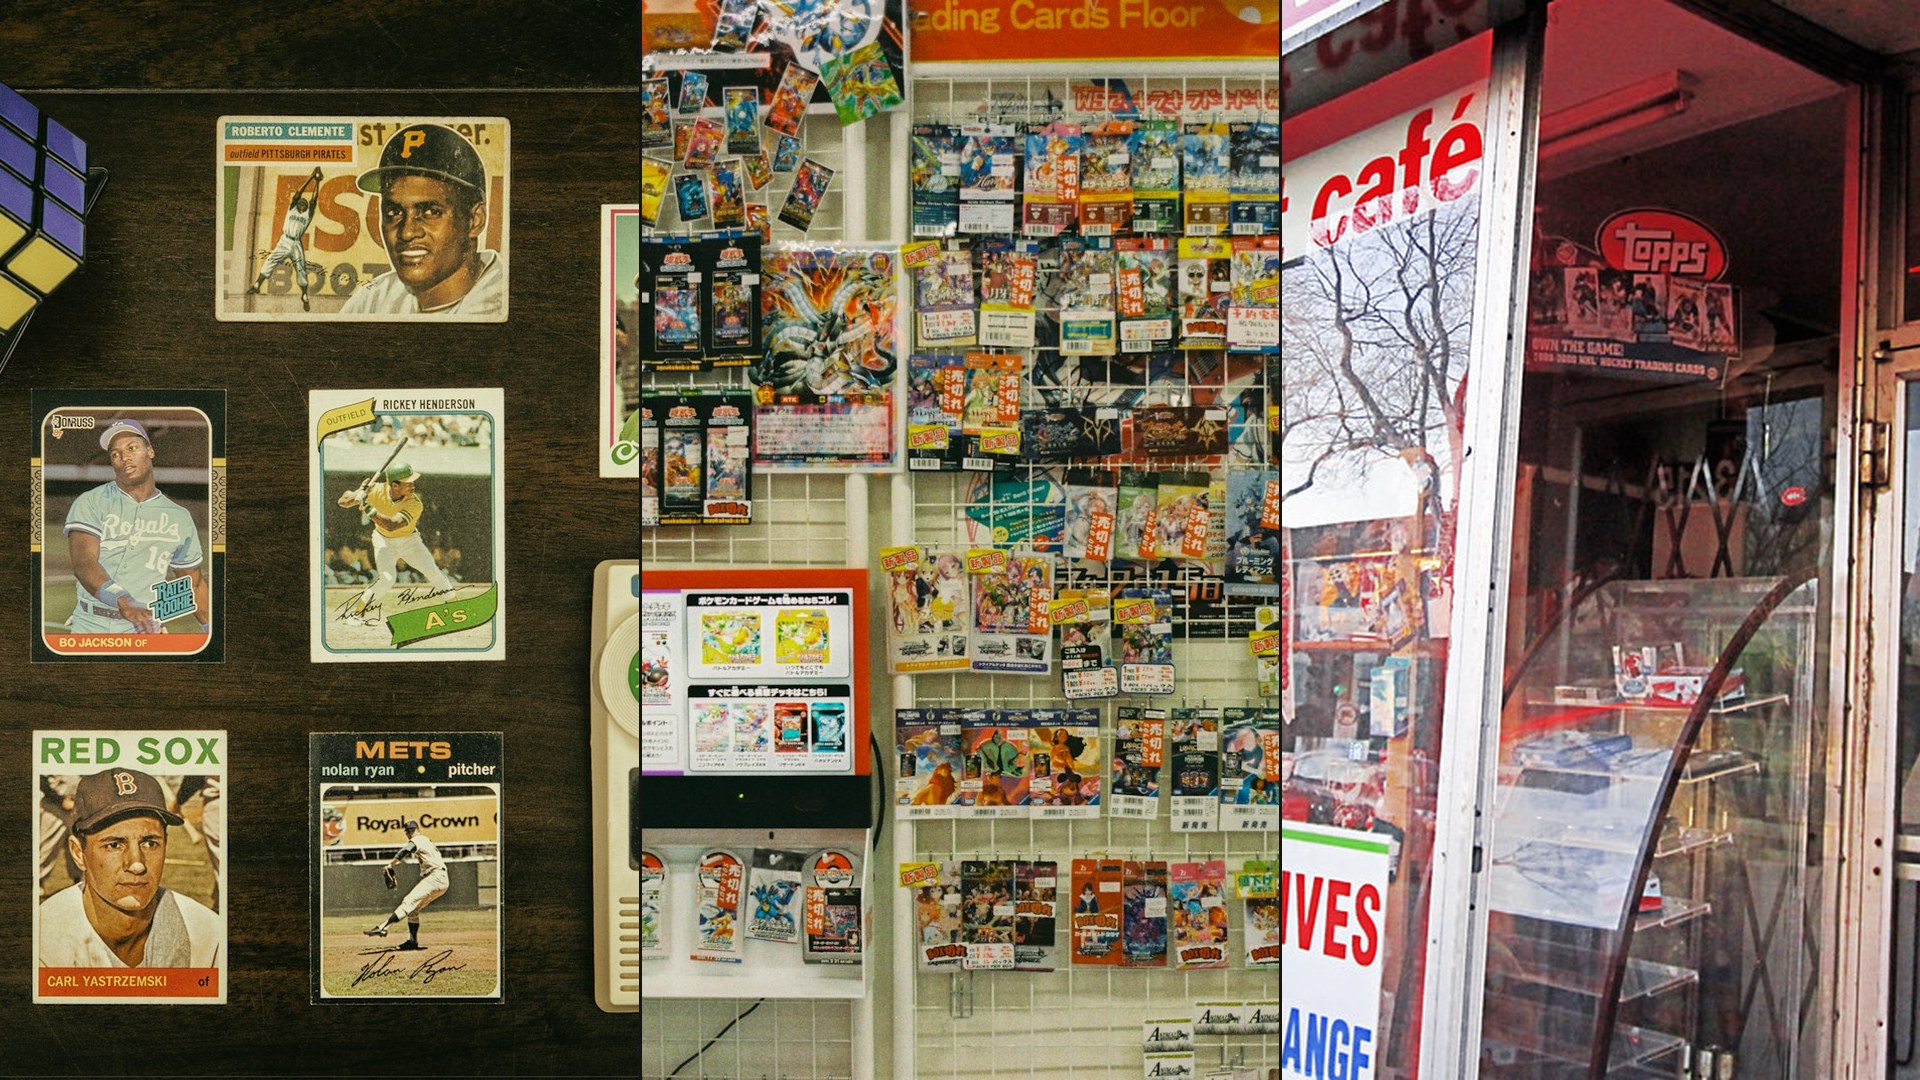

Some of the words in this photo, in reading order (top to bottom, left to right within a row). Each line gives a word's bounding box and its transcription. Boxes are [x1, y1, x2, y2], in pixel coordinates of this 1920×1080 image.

[1010, 0, 1108, 30] Cards
[1120, 0, 1205, 29] Floor
[232, 127, 282, 136] ROBERTO
[288, 127, 345, 136] CLEMENTE
[230, 149, 260, 159] outfield
[262, 149, 310, 159] PITTSBURGH
[313, 149, 346, 159] PIRATES
[1310, 92, 1483, 247] café
[1063, 160, 1077, 200] 売切れ
[1020, 265, 1034, 304] 売切れ
[1127, 273, 1143, 313] 売切れ
[1532, 338, 1558, 351] OWN
[1561, 340, 1584, 353] THE
[1588, 342, 1624, 356] GAME!
[1600, 357, 1633, 368] HOCKEY
[1635, 360, 1673, 372] TRADING
[1676, 363, 1705, 374] CARDS
[950, 370, 964, 409] 売切れ
[1005, 375, 1018, 415] 売切れ
[384, 400, 416, 410] RICKEY
[420, 400, 476, 410] HENDERSON
[52, 415, 94, 429] DONRUSS
[326, 410, 366, 426] OUTFIELD
[911, 428, 947, 445] 新製品
[982, 434, 1018, 450] 新製品
[101, 513, 180, 545] Royals
[1094, 516, 1112, 556] 売切れ
[1191, 511, 1208, 550] 売切れ
[882, 550, 918, 569] 新製品
[968, 552, 1004, 570] 新製品
[1236, 557, 1274, 566] ブルーミング
[152, 581, 190, 600] RATED
[150, 596, 196, 619] ROOKIE
[1037, 589, 1051, 628] 売切れ
[1052, 602, 1088, 622] 新製品
[1117, 602, 1153, 620] 新製品
[425, 609, 468, 630] A's
[60, 638, 75, 648] BO
[79, 638, 132, 648] JACKSON
[135, 638, 148, 648] OF
[41, 738, 120, 764] RED
[137, 738, 220, 765] SOX
[356, 741, 452, 760] METS
[1149, 724, 1162, 762] 売切れ
[322, 764, 358, 776] nolan
[365, 765, 394, 778] ryan
[448, 763, 496, 778] pitcher
[114, 772, 137, 795] B
[357, 816, 407, 833] Royal
[420, 814, 479, 829] Crown
[725, 864, 741, 903] 売切れ
[902, 865, 938, 885] 新製品
[813, 890, 825, 930] 売切れ
[47, 976, 79, 987] CARL
[83, 976, 167, 987] YASTRZEMSKI
[198, 976, 209, 988] of
